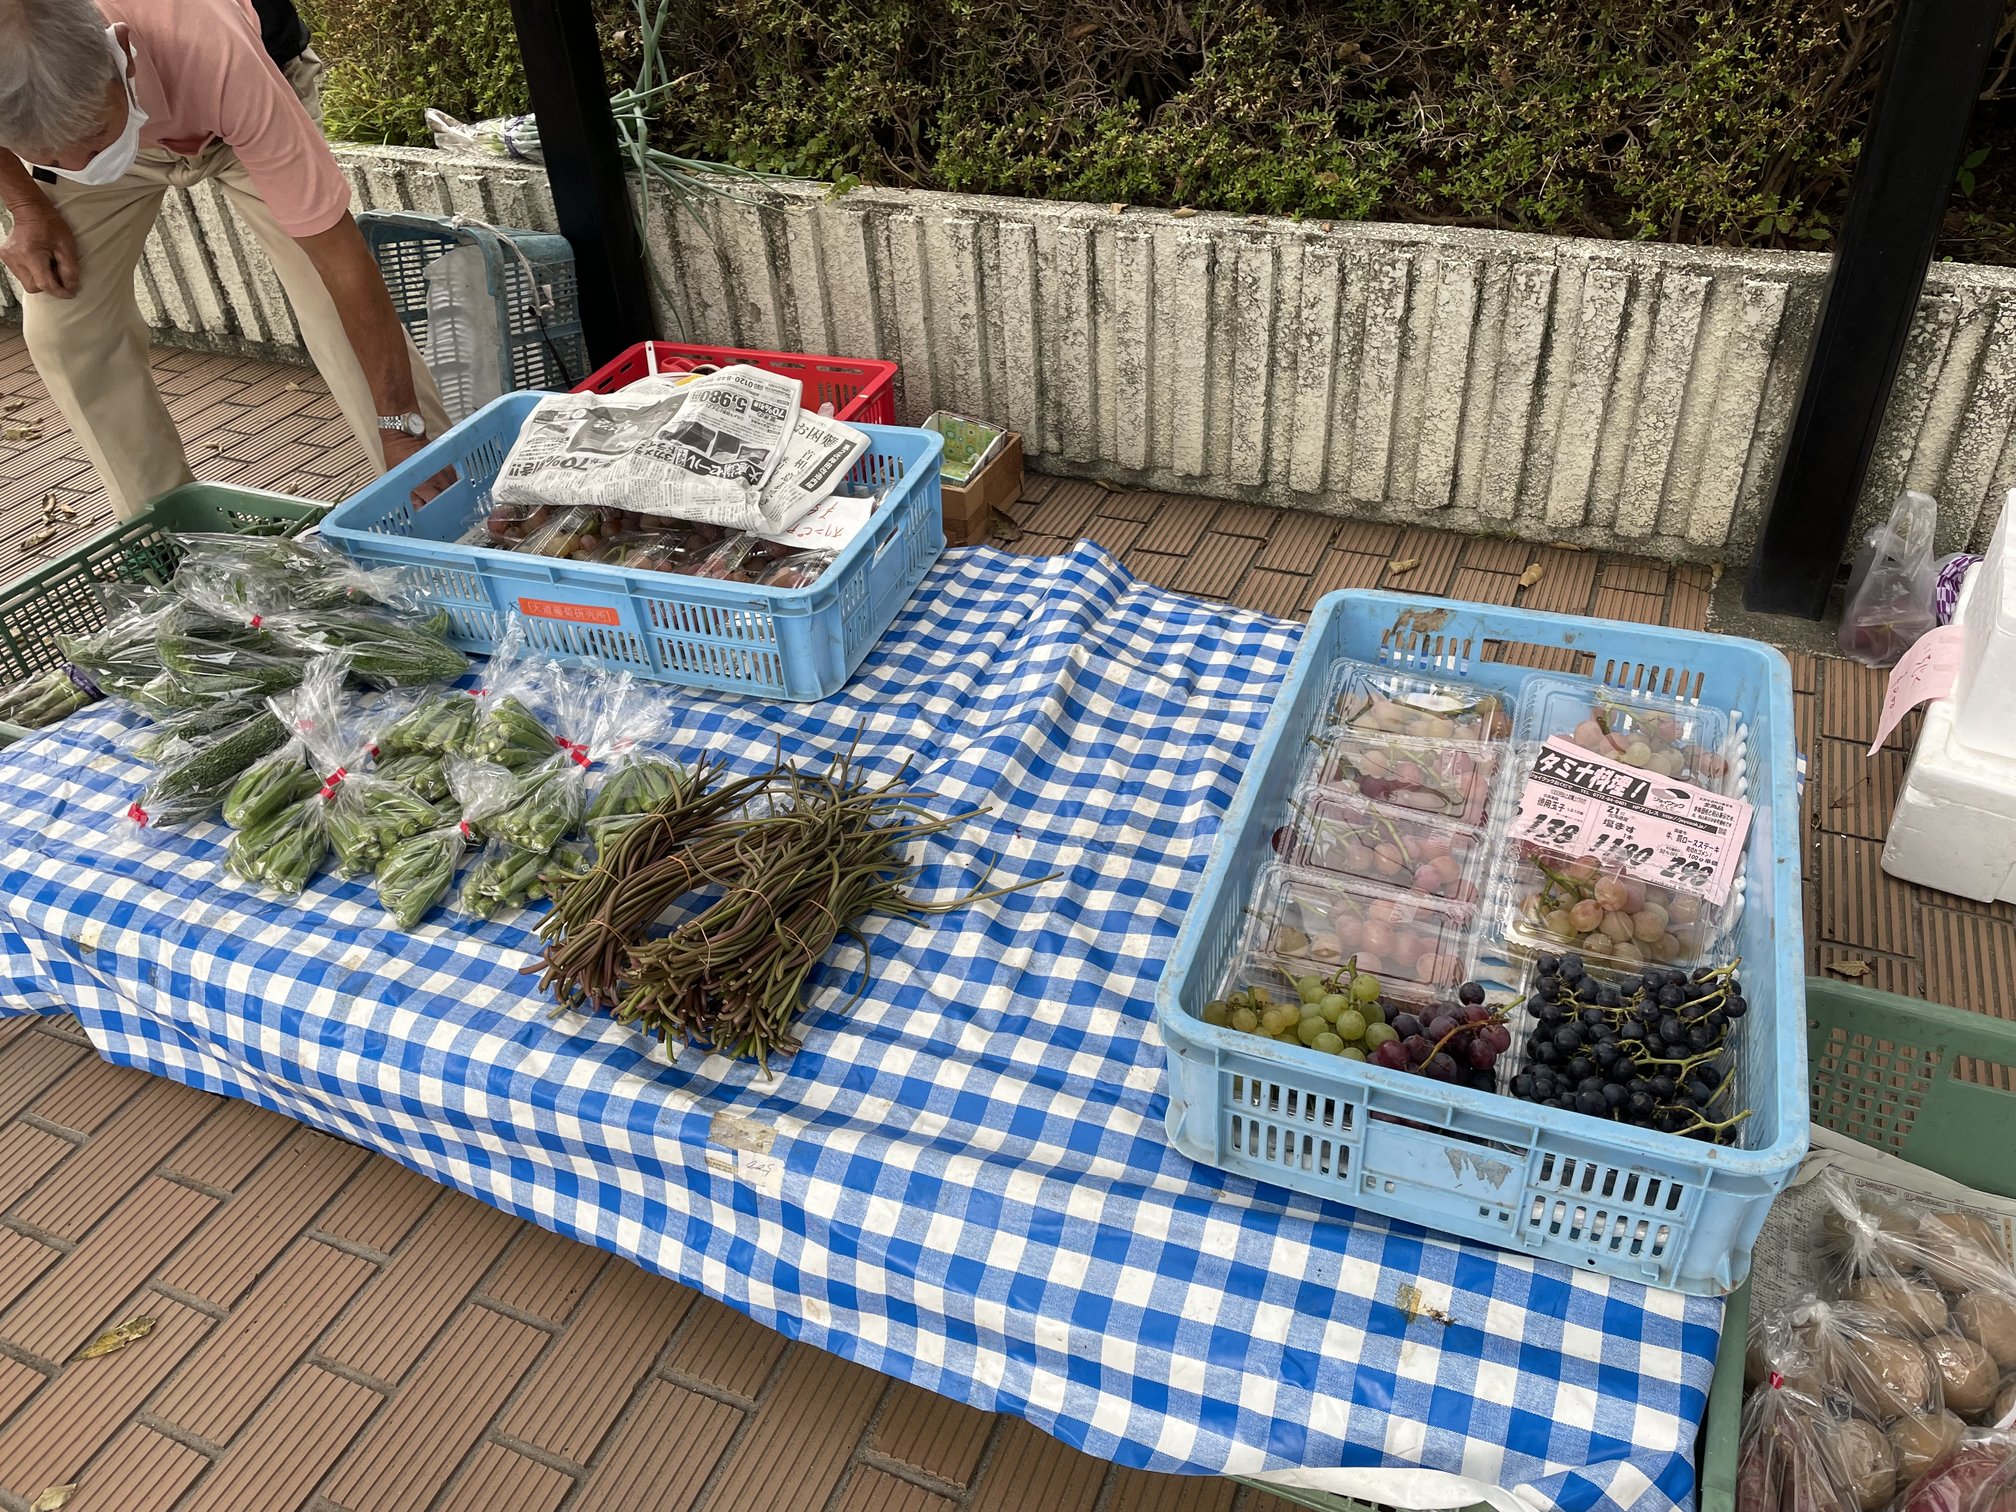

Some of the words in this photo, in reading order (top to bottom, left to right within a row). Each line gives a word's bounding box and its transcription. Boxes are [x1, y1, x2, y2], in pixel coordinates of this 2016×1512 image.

[1539, 748, 1647, 799] タミナ料理！
